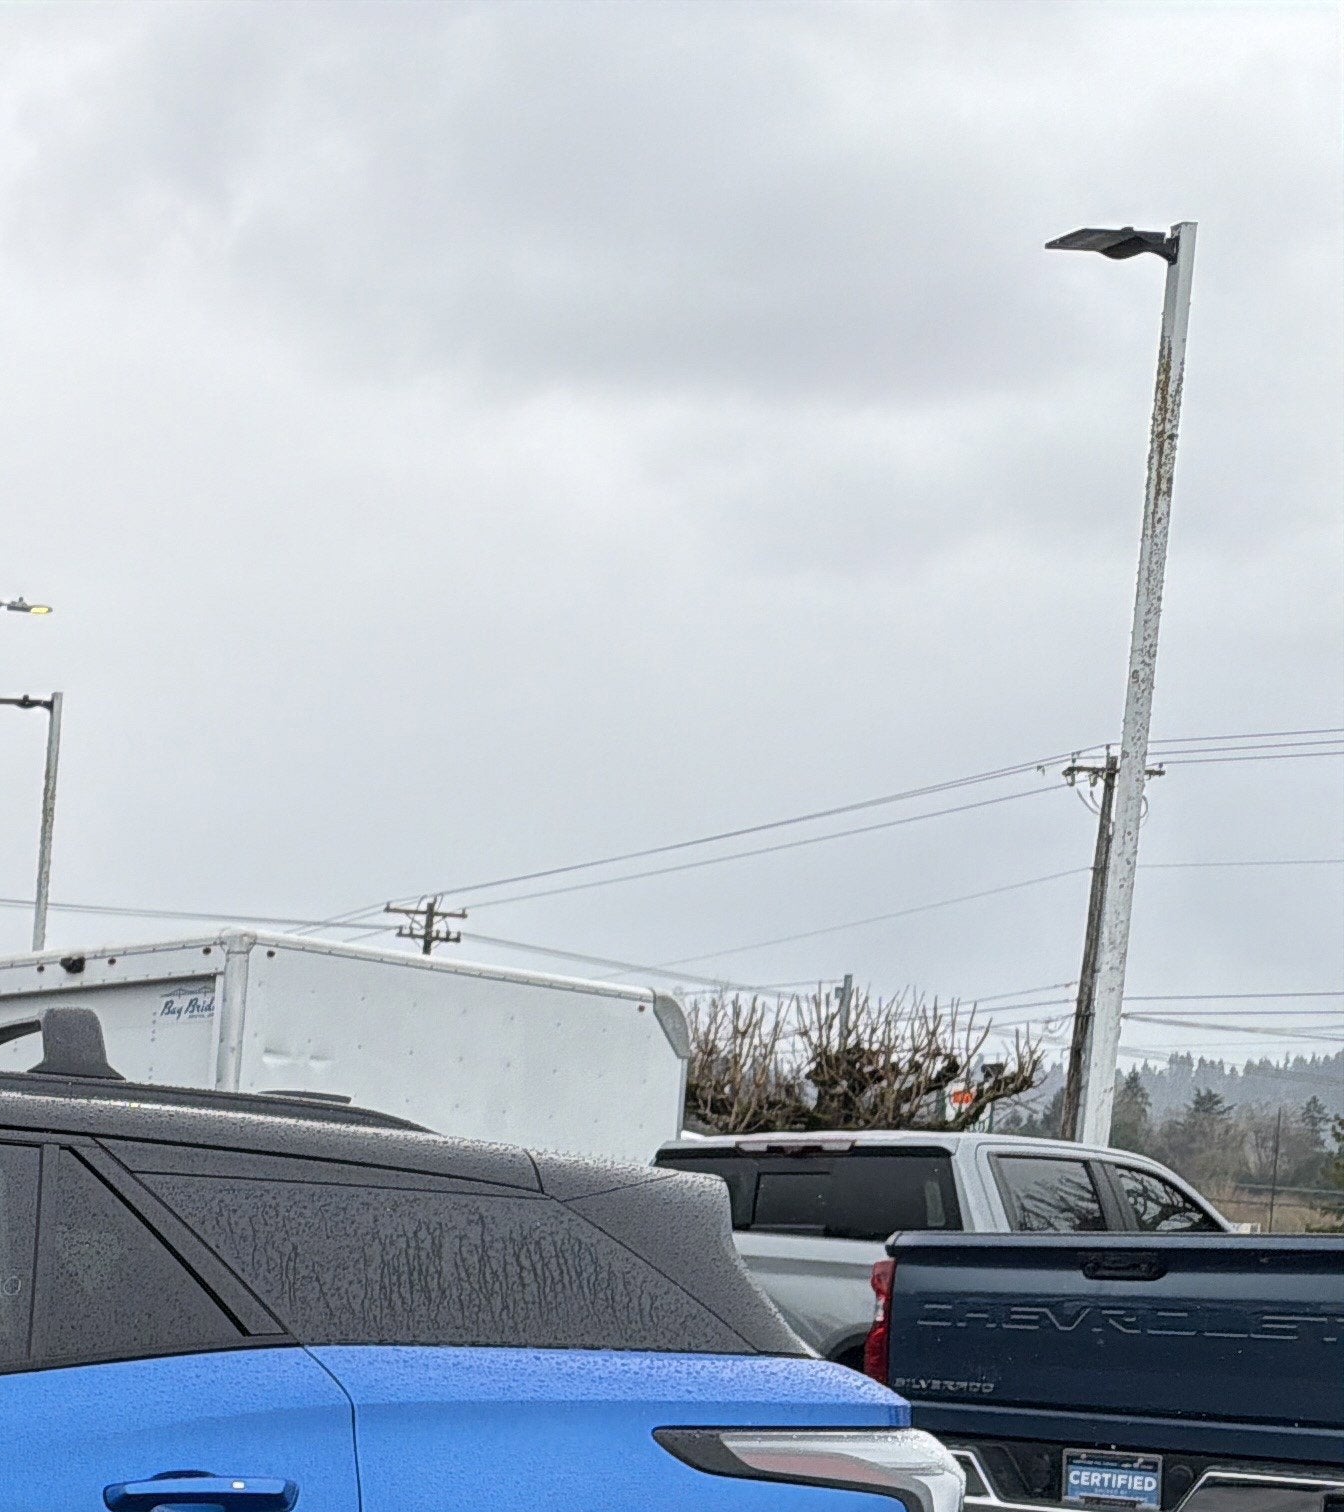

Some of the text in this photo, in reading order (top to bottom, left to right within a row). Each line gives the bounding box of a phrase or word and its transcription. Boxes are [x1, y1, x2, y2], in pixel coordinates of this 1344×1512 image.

[160, 999, 183, 1020] Bay
[894, 1377, 995, 1393] SILVERADO
[1069, 1470, 1157, 1491] CERTIFIED
